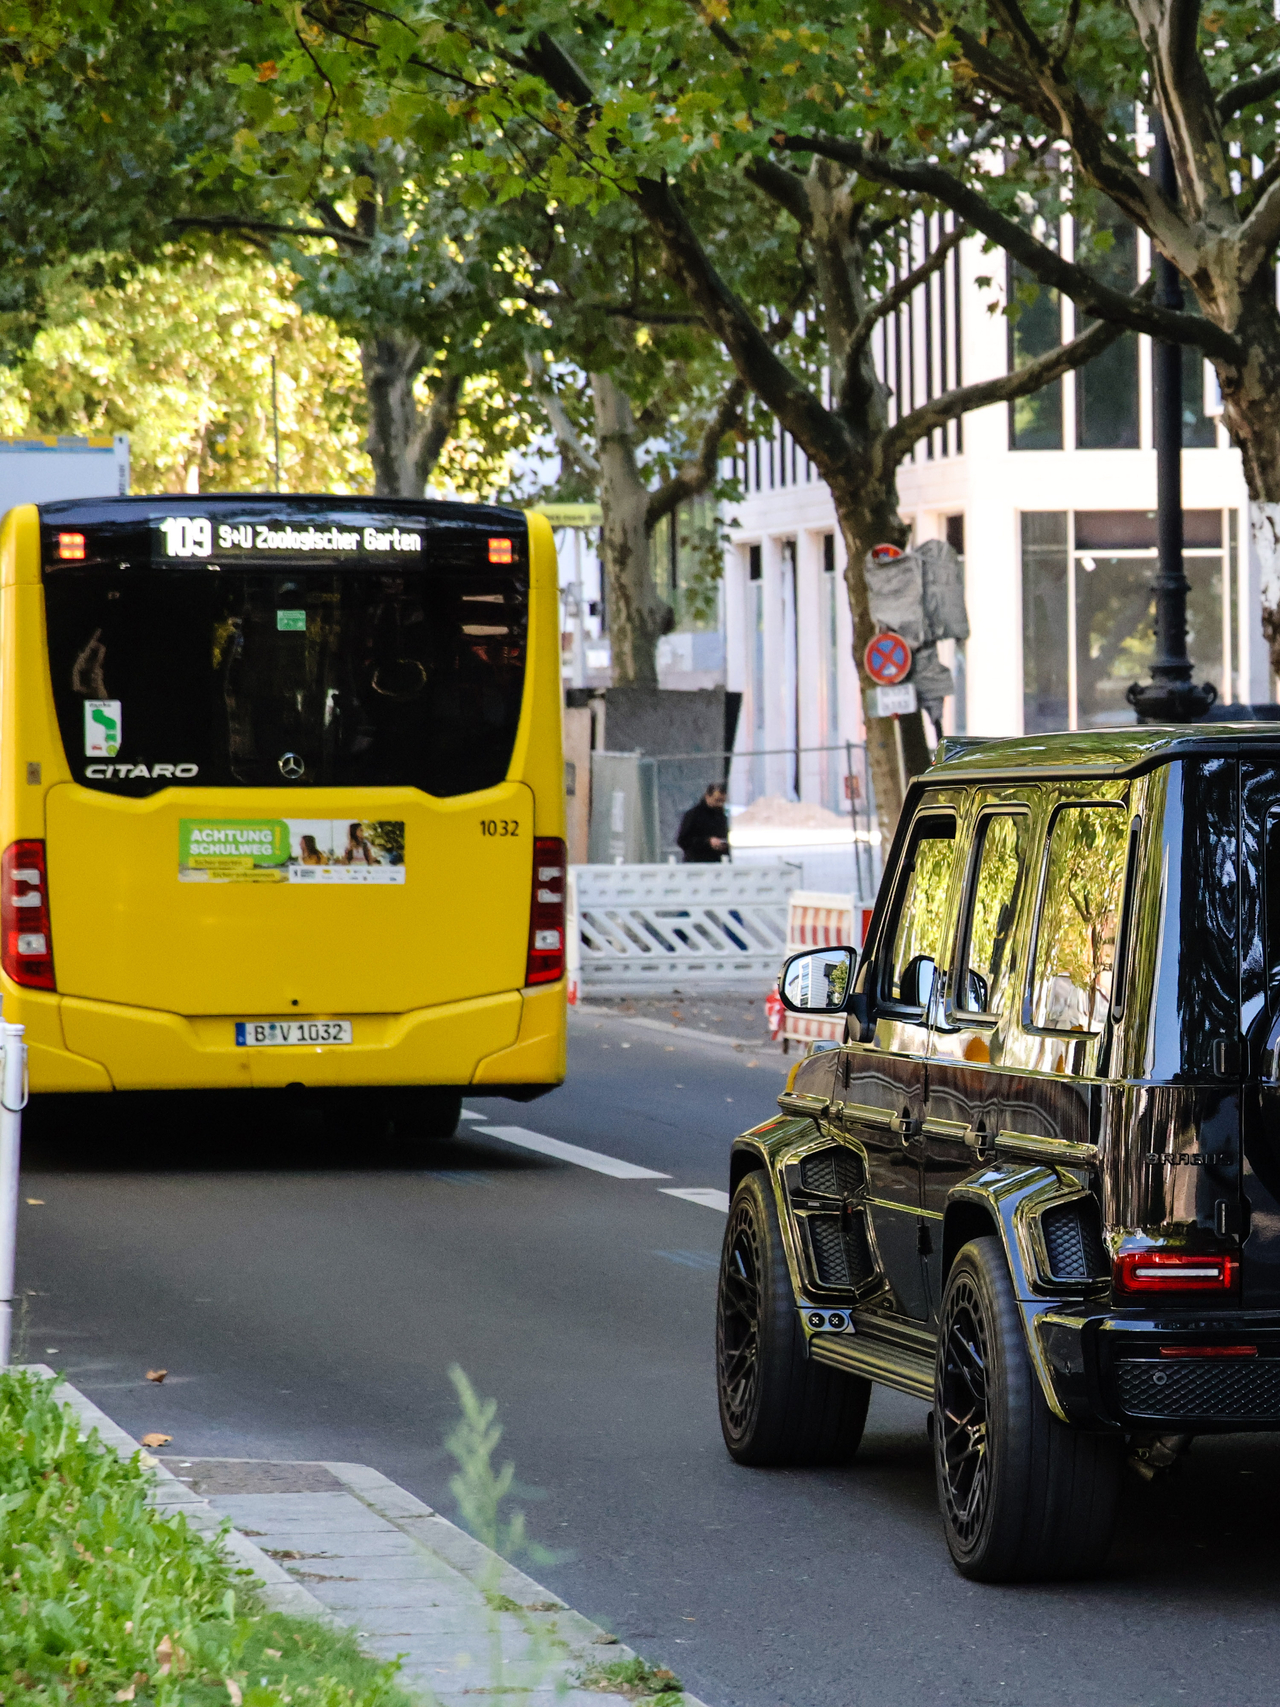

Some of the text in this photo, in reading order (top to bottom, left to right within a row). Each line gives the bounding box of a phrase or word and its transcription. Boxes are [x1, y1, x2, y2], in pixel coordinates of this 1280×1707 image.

[160, 517, 421, 557] 109 S+U Zoologischer Garten
[85, 763, 199, 778] CITARO
[191, 829, 273, 842] ACHTUNG
[480, 820, 519, 836] 1032
[189, 843, 273, 855] SCHULWEG
[254, 1024, 343, 1042] B V 1032
[1146, 1152, 1235, 1166] BRABUS
